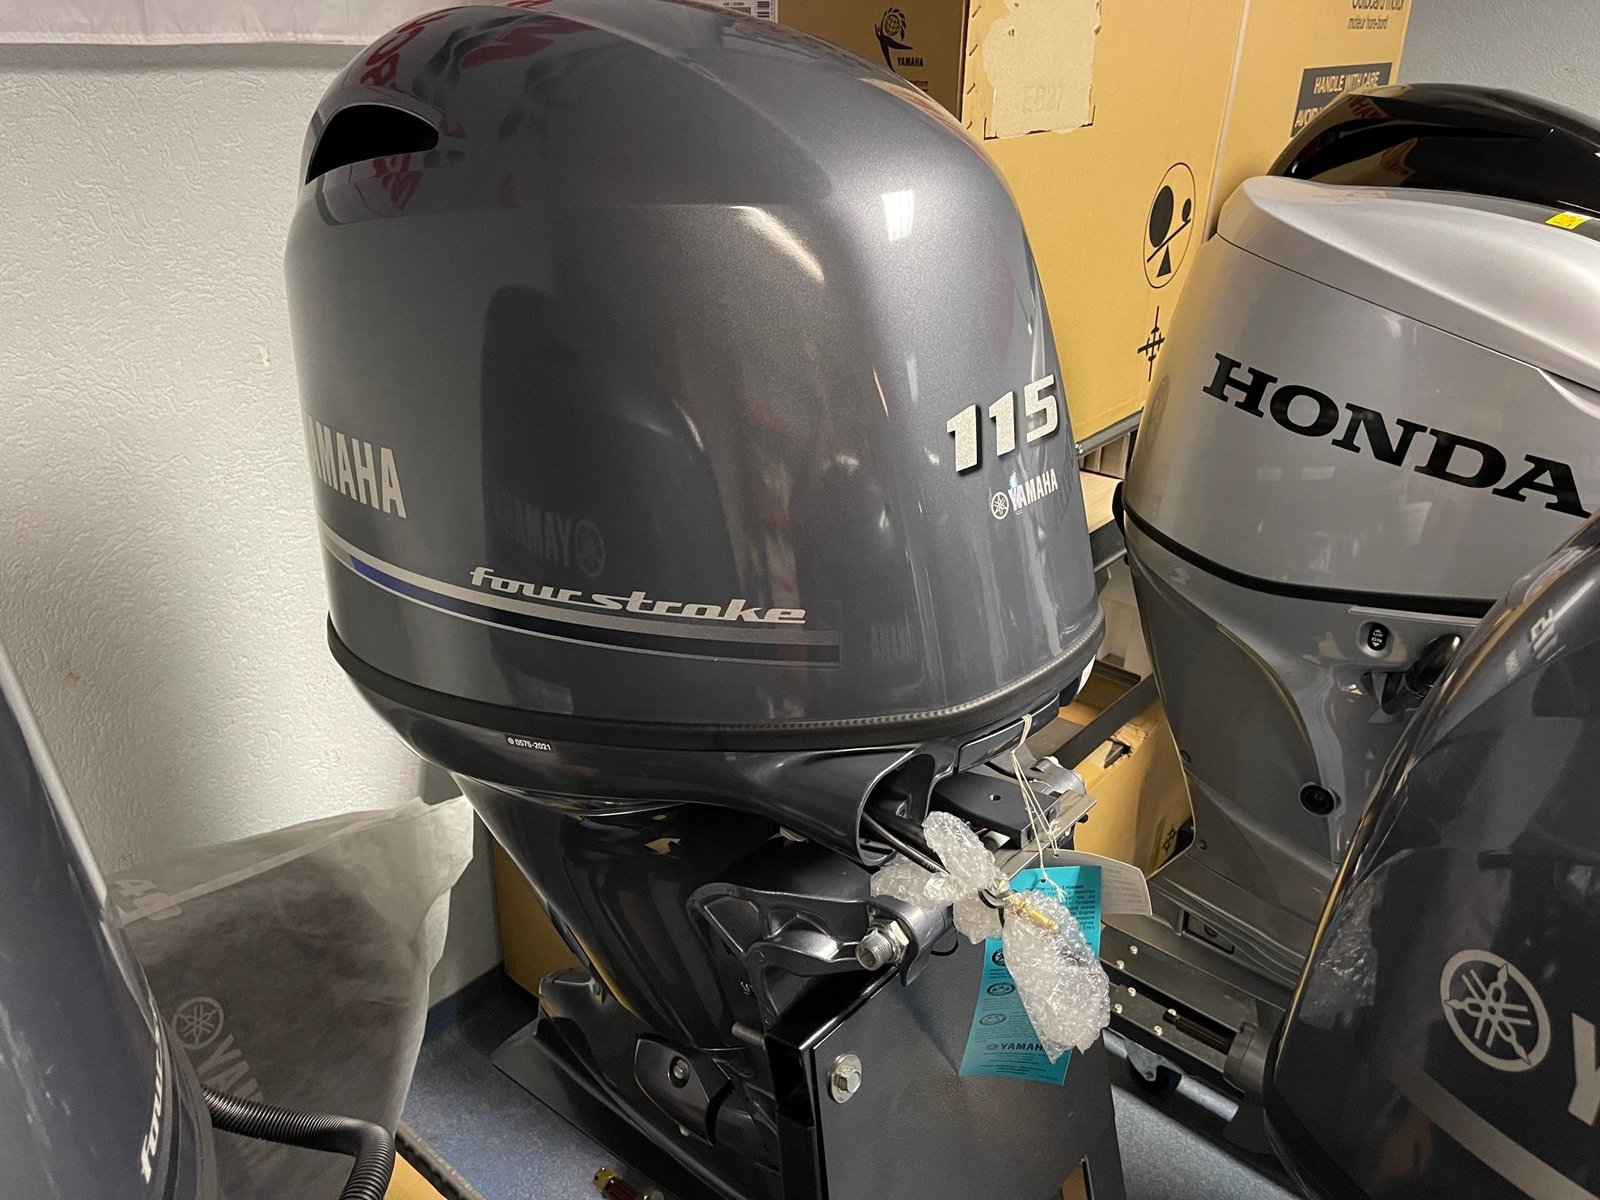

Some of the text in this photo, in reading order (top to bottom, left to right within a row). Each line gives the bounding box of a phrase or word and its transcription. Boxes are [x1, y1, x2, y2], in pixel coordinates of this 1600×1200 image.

[897, 56, 924, 68] YAMAHA
[1313, 71, 1380, 95] HANDLE WITH CARE
[946, 374, 1059, 473] 115
[1202, 352, 1592, 519] HONDA
[304, 412, 408, 520] AMAHA
[1008, 468, 1059, 512] YAMAHA
[470, 566, 806, 624] four stroke
[1001, 1042, 1044, 1051] YAMAH
